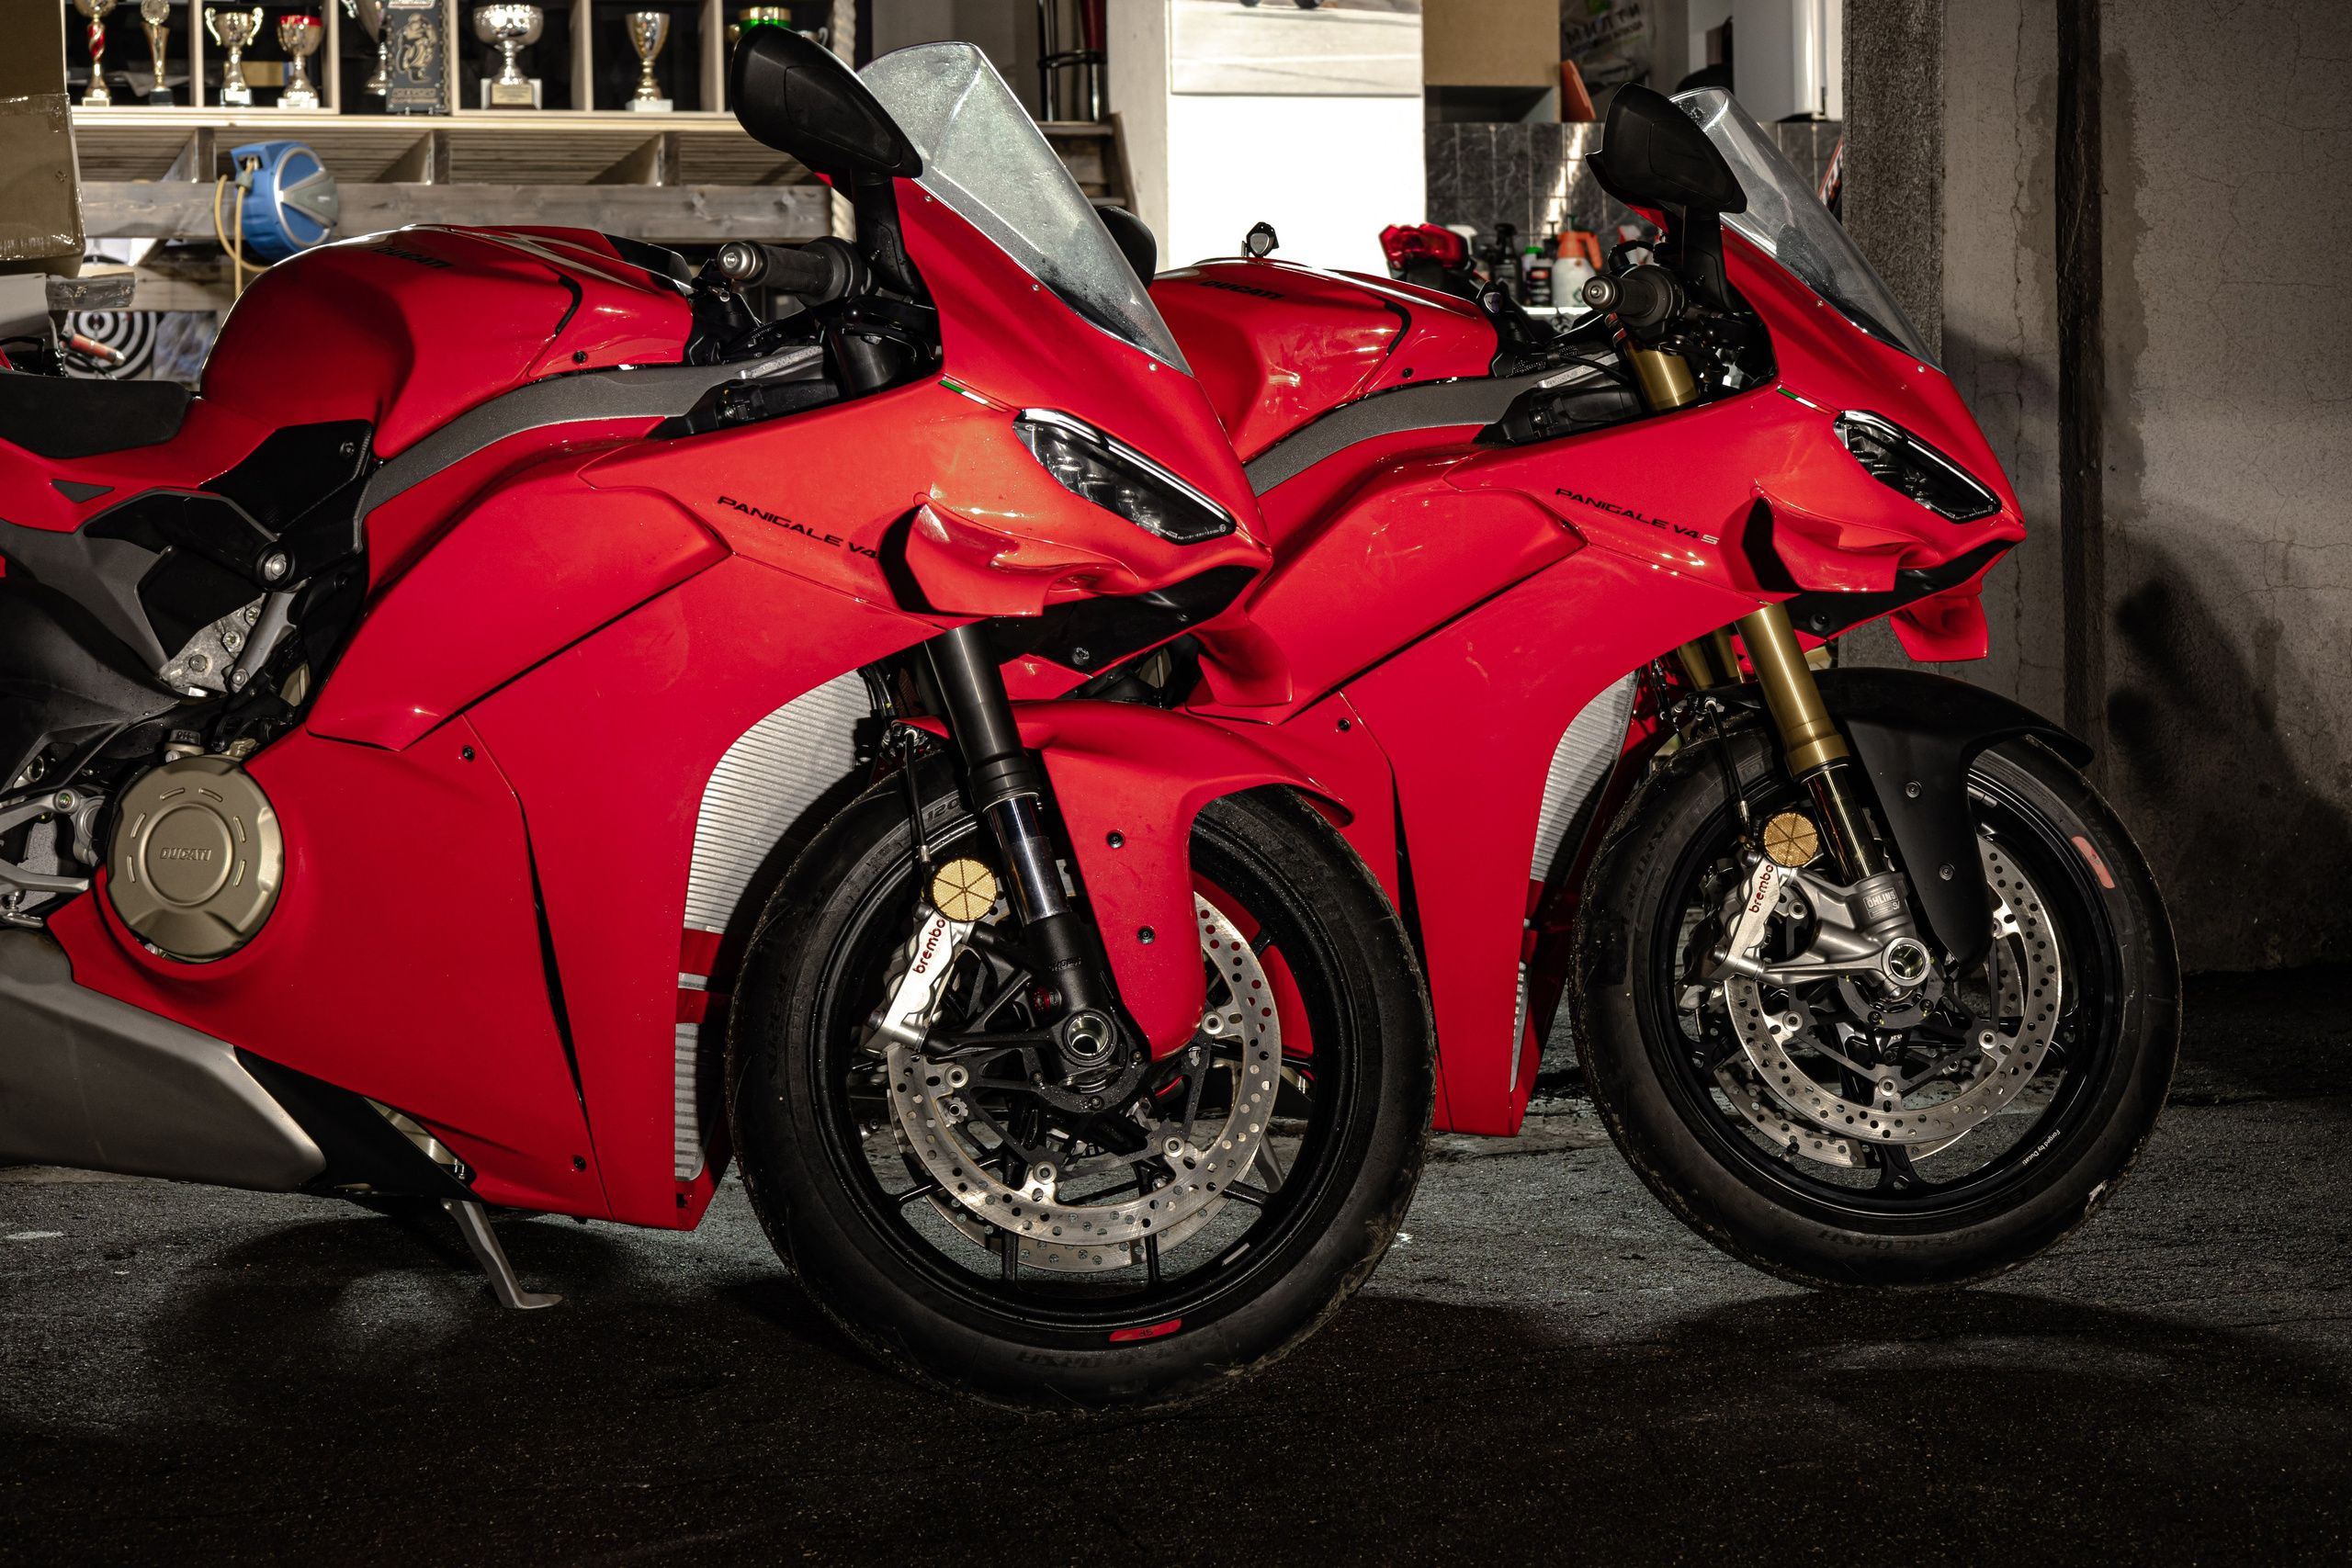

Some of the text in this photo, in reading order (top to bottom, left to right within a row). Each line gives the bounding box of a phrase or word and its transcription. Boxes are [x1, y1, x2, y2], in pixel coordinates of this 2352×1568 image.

[371, 246, 454, 269] DUCATI
[1198, 279, 1286, 300] DUCATI
[1555, 488, 1669, 530] PANIGALE
[718, 495, 878, 558] PANIGALE V4
[160, 847, 212, 861] DUCATI
[1748, 864, 1774, 914] brembo
[1866, 891, 1896, 908] ÖHLINS
[912, 919, 946, 974] brembo
[2043, 1129, 2061, 1147] Forged
[2021, 1150, 2040, 1166] Ducati
